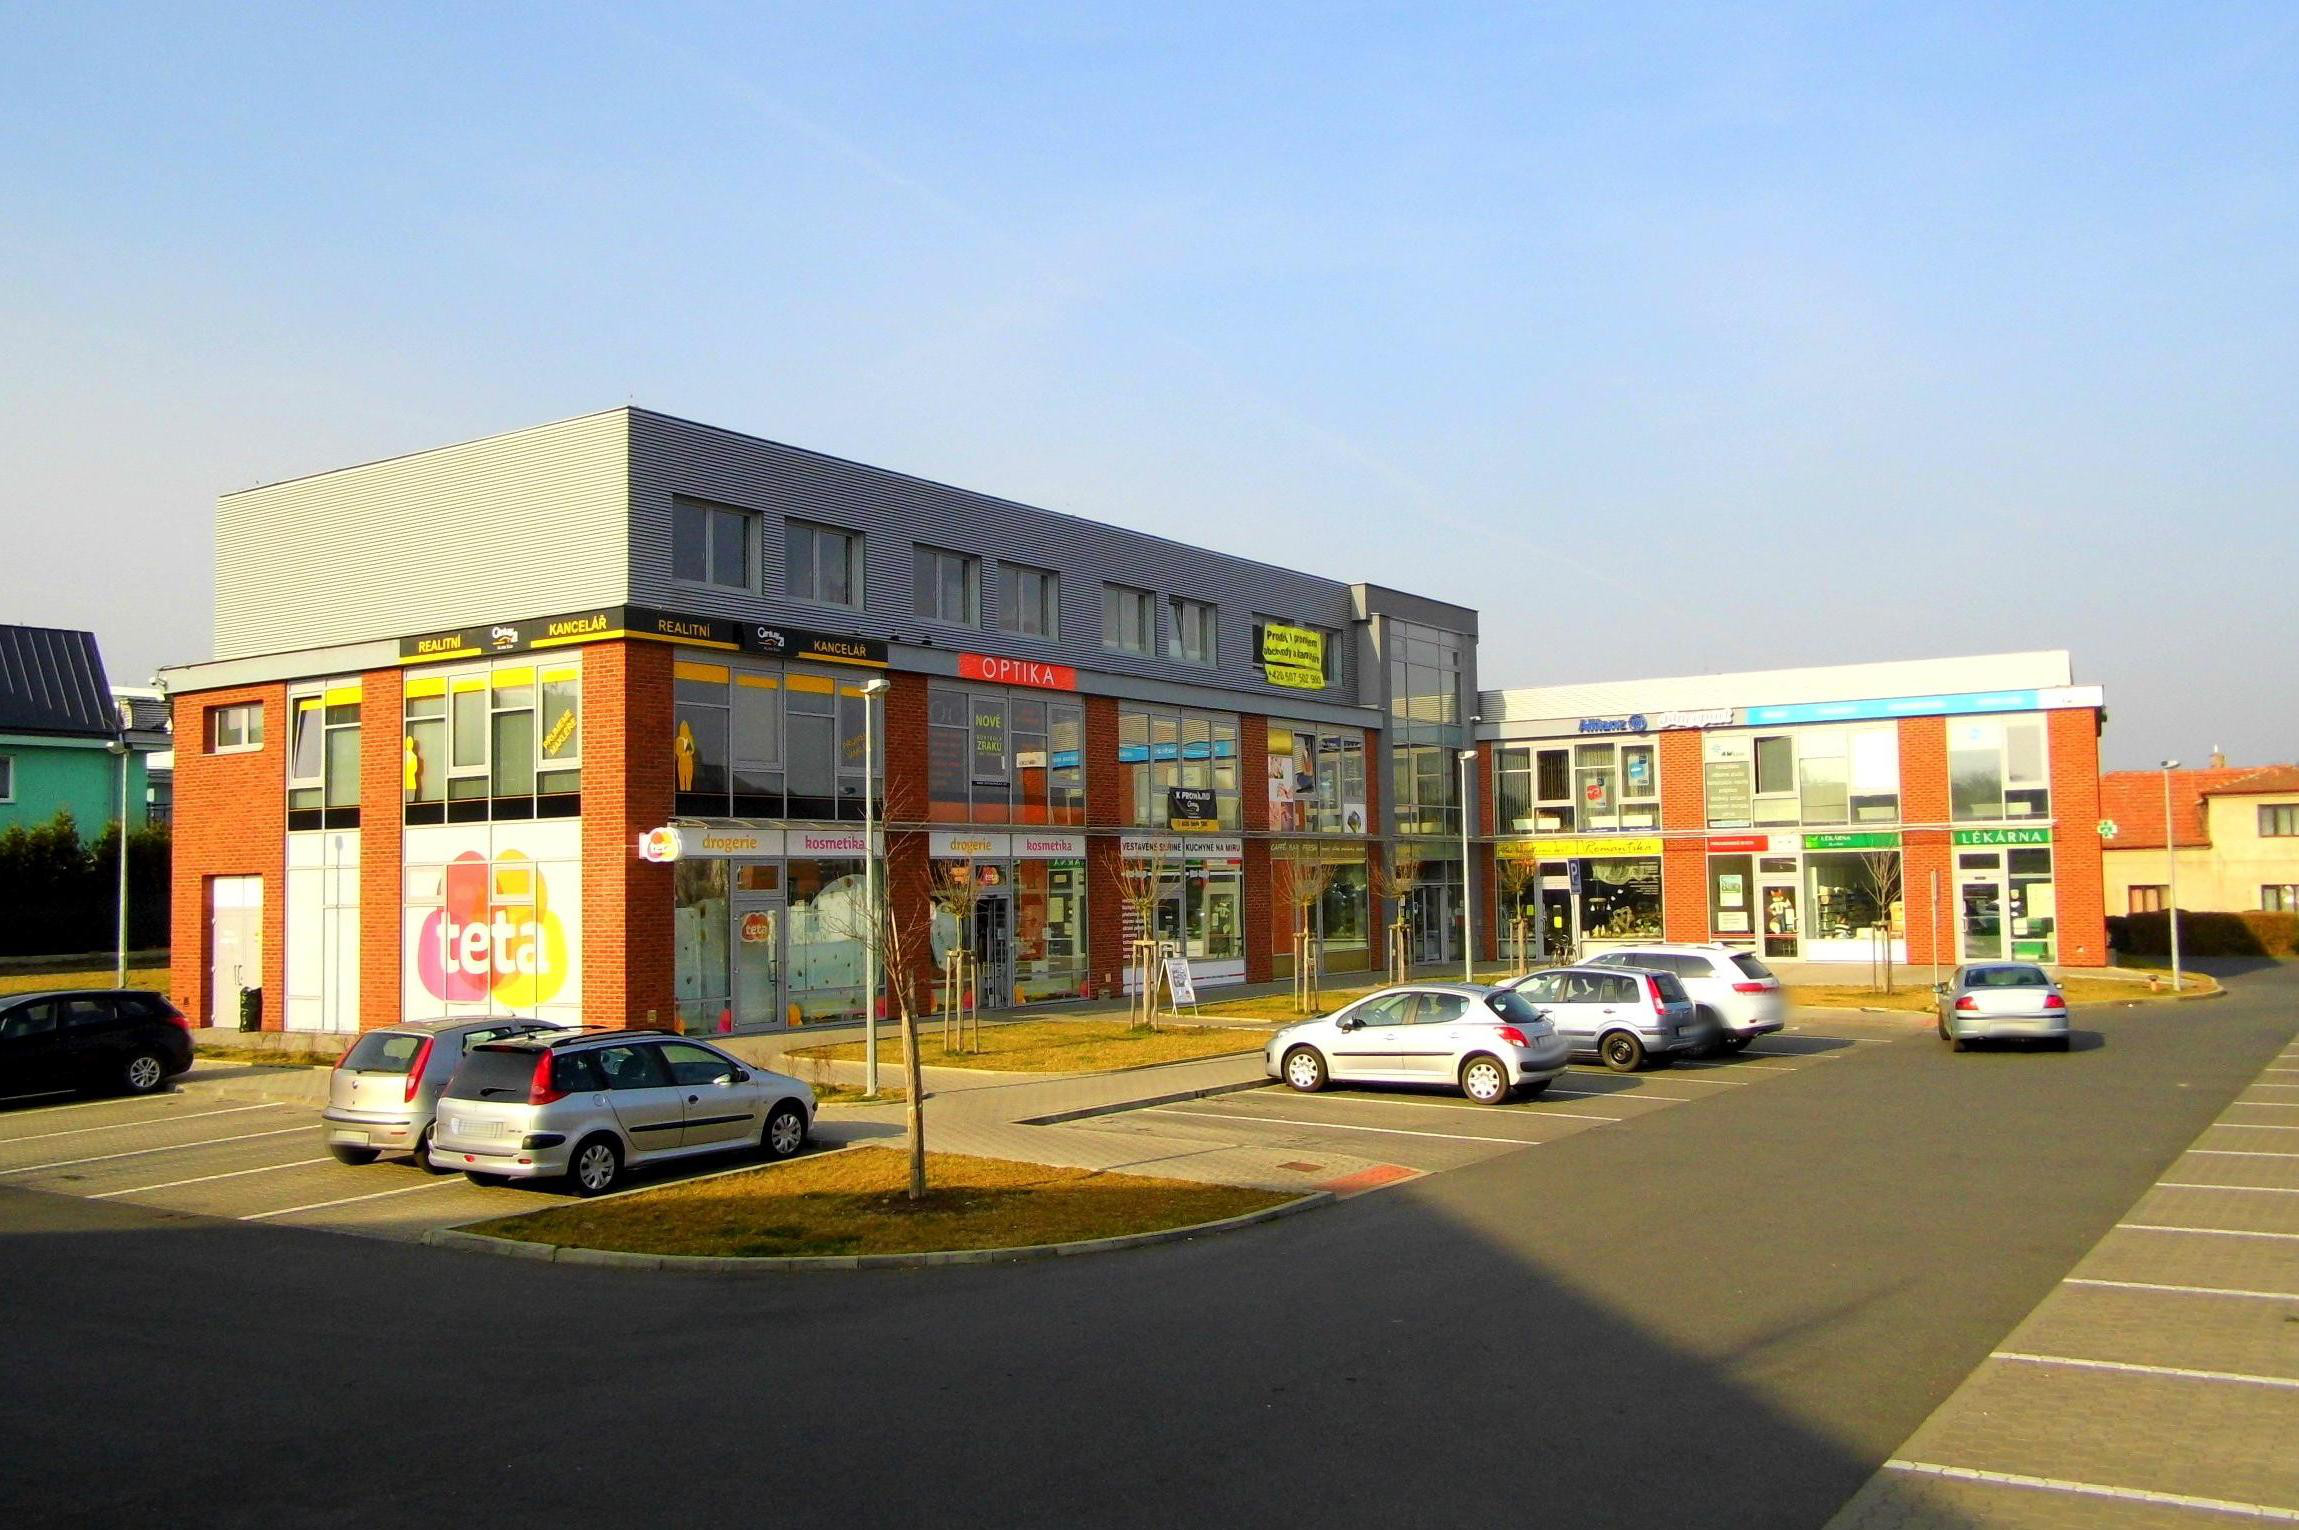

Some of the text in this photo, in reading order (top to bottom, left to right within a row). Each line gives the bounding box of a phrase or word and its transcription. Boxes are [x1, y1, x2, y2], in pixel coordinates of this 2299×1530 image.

[549, 614, 607, 636] KANCELÁŘ
[658, 619, 711, 638] REALITNÍ
[418, 634, 461, 653] REALITNÍ
[813, 640, 867, 657] KANCELÁŘ
[982, 657, 1055, 686] OPTIKA
[1578, 718, 1627, 733] Allianz
[976, 740, 1002, 752] ZRAKU
[702, 833, 758, 853] drogerie
[805, 835, 866, 851] kosmetika
[1026, 838, 1072, 852] kosmetika
[1961, 830, 2043, 844] LÉKÁRNA
[950, 837, 992, 855] drogerie
[1216, 843, 1224, 852] NA
[436, 909, 550, 975] teta
